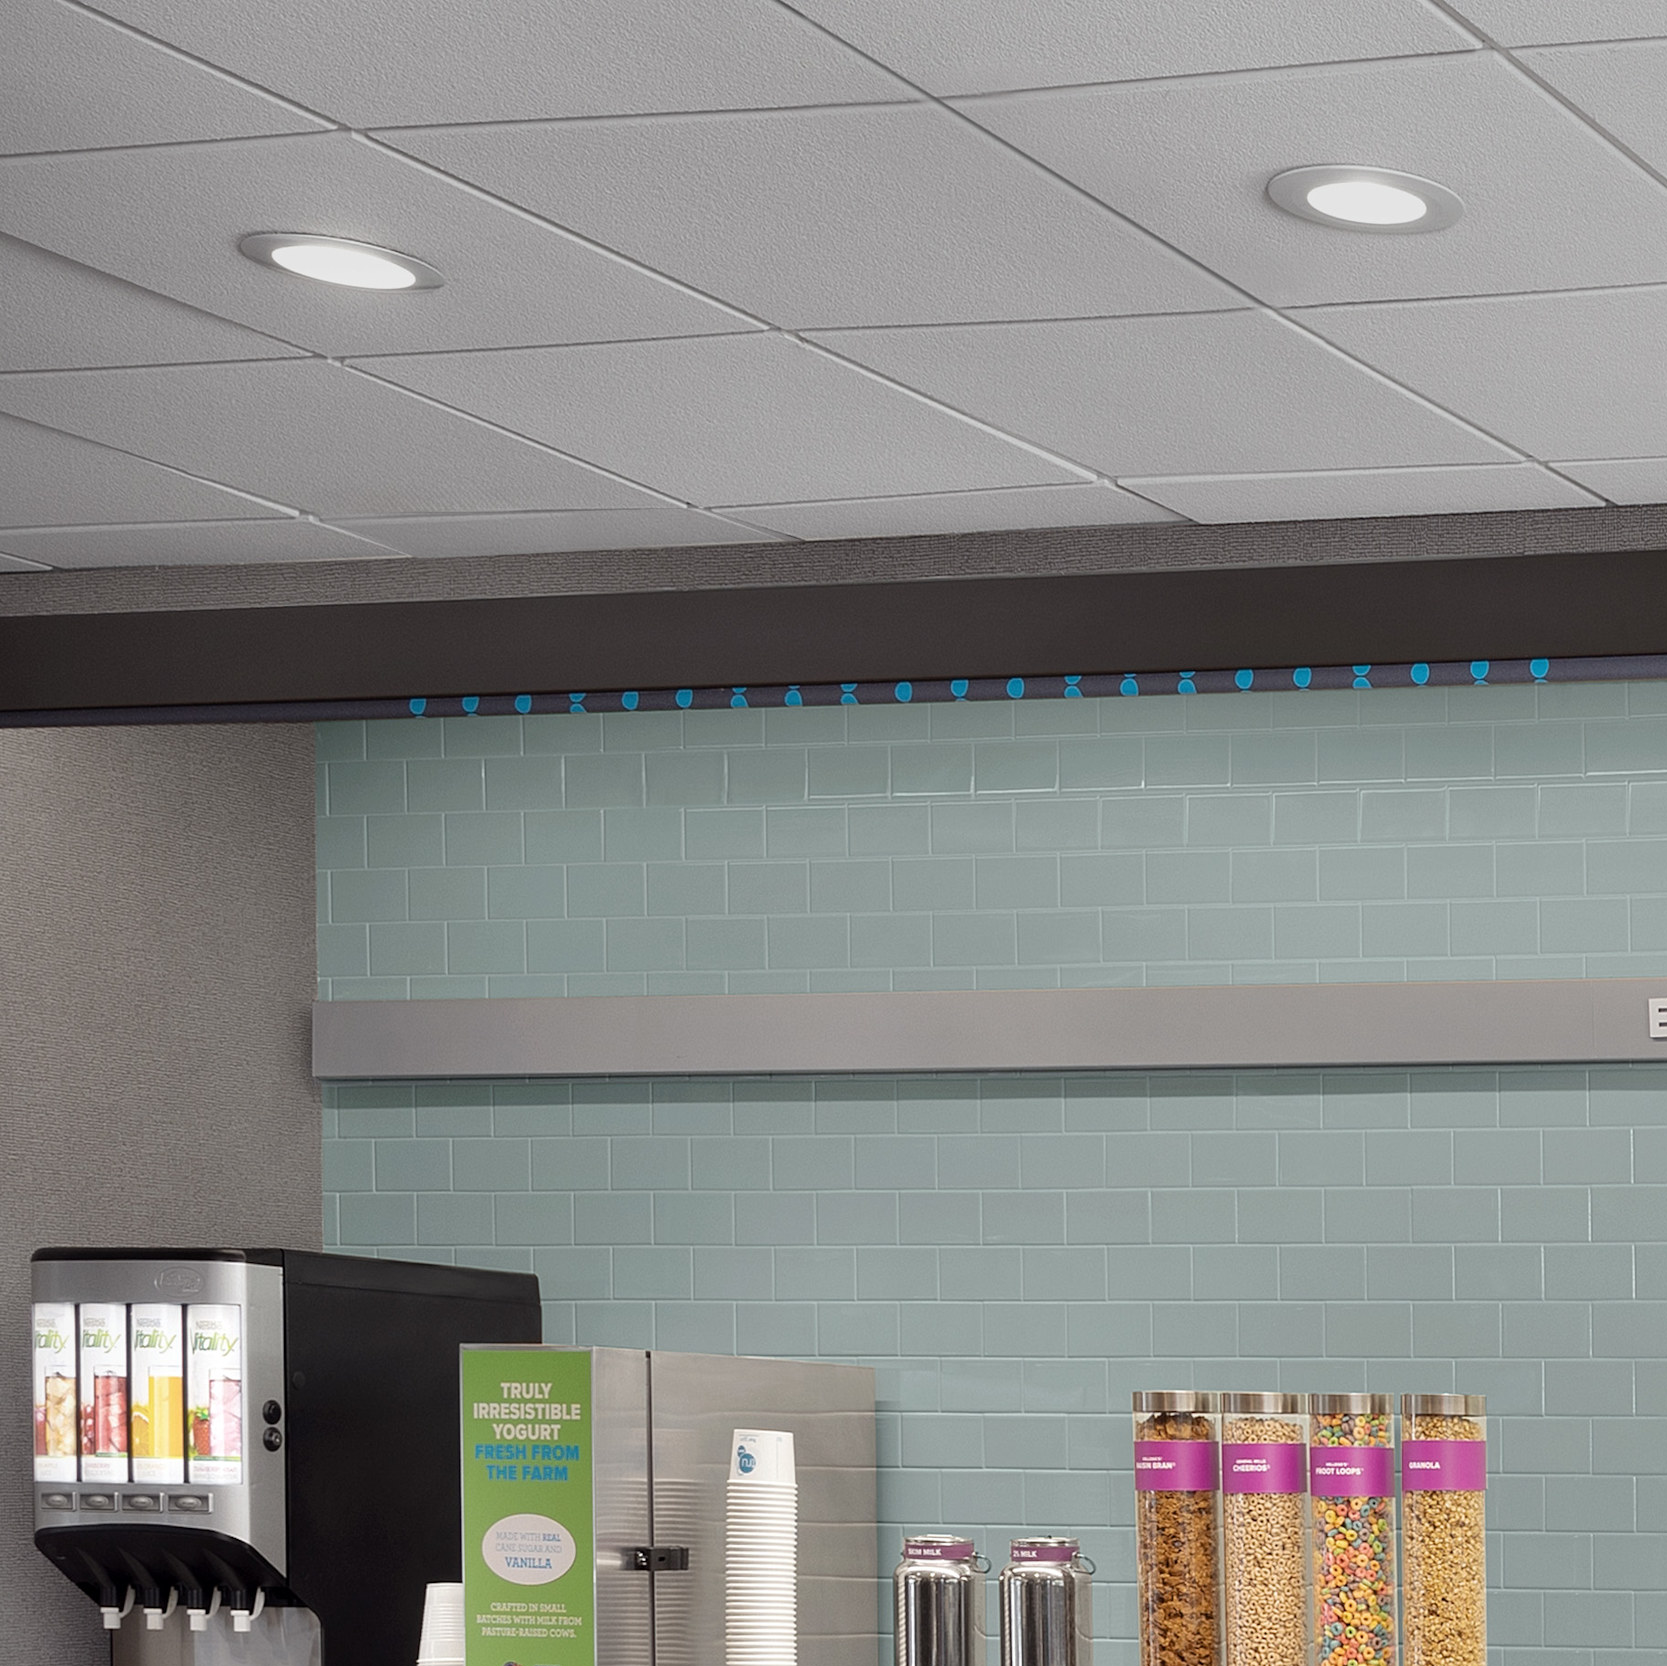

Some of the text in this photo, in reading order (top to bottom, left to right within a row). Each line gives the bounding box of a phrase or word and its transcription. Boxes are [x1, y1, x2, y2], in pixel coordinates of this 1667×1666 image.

[500, 1382, 552, 1399] TRULY
[473, 1402, 581, 1420] IRRESISTIBLE
[492, 1423, 561, 1440] YOGURT
[475, 1444, 579, 1461] FRESH FROM
[486, 1465, 568, 1481] THE FARM
[496, 1531, 561, 1542] MADE WITH REAL
[496, 1543, 562, 1553] CANE SUGAR AND
[923, 1548, 942, 1556] MILK
[1020, 1550, 1037, 1558] MILK
[505, 1556, 552, 1569] VANILLA
[490, 1602, 567, 1613] CRAFTED IN SMALL
[476, 1614, 582, 1626] BATCHES WITH MILK FROM
[481, 1627, 548, 1637] PASTURE-RAISED
